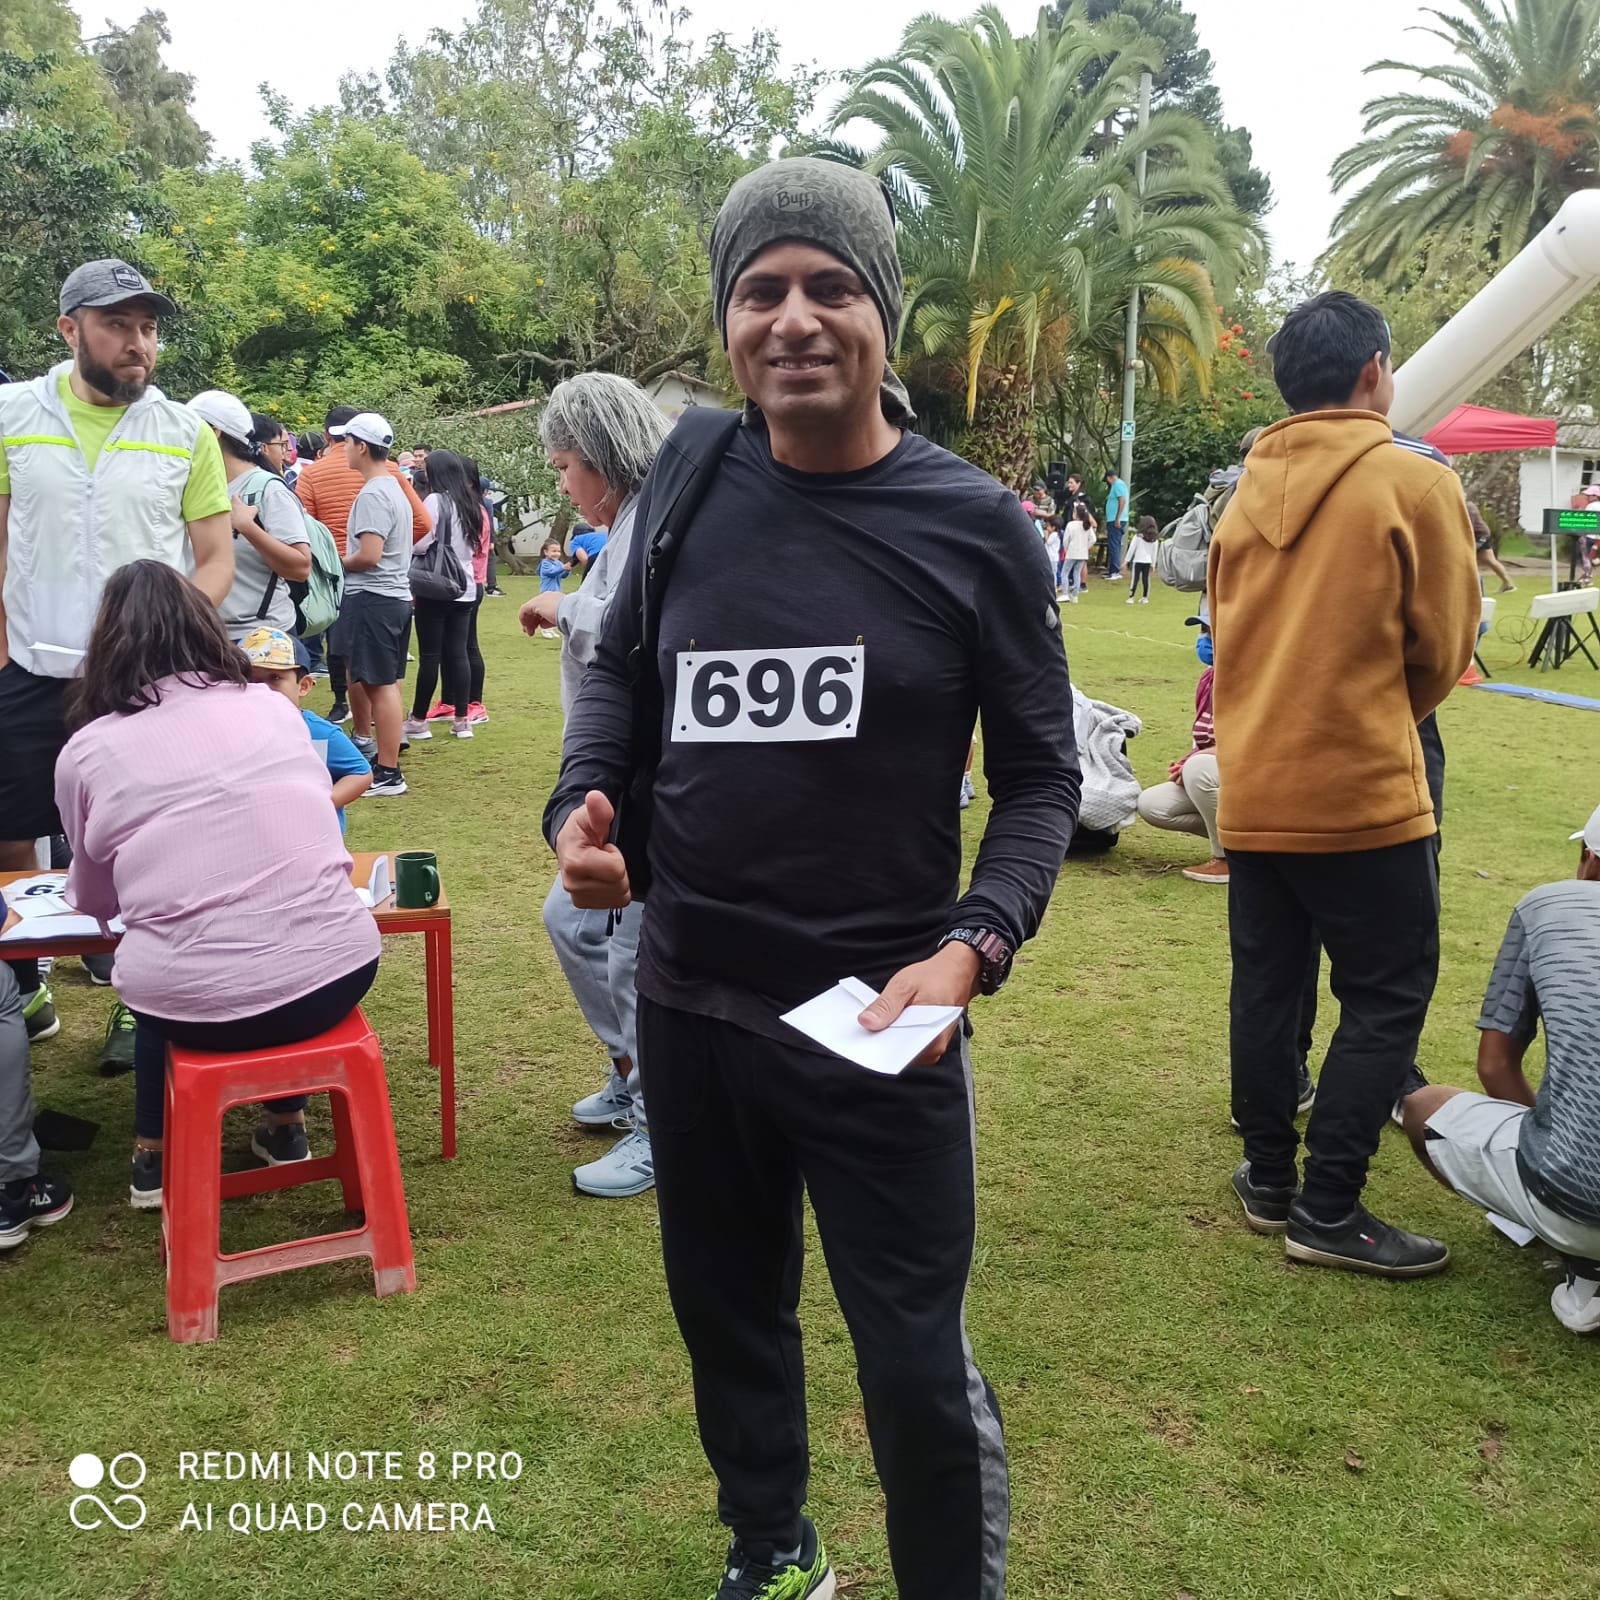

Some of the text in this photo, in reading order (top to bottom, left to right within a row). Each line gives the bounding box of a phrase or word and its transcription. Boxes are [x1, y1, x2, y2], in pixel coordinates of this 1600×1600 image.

[777, 191, 811, 208] Buff
[691, 655, 854, 728] 696
[29, 1192, 52, 1208] FILA
